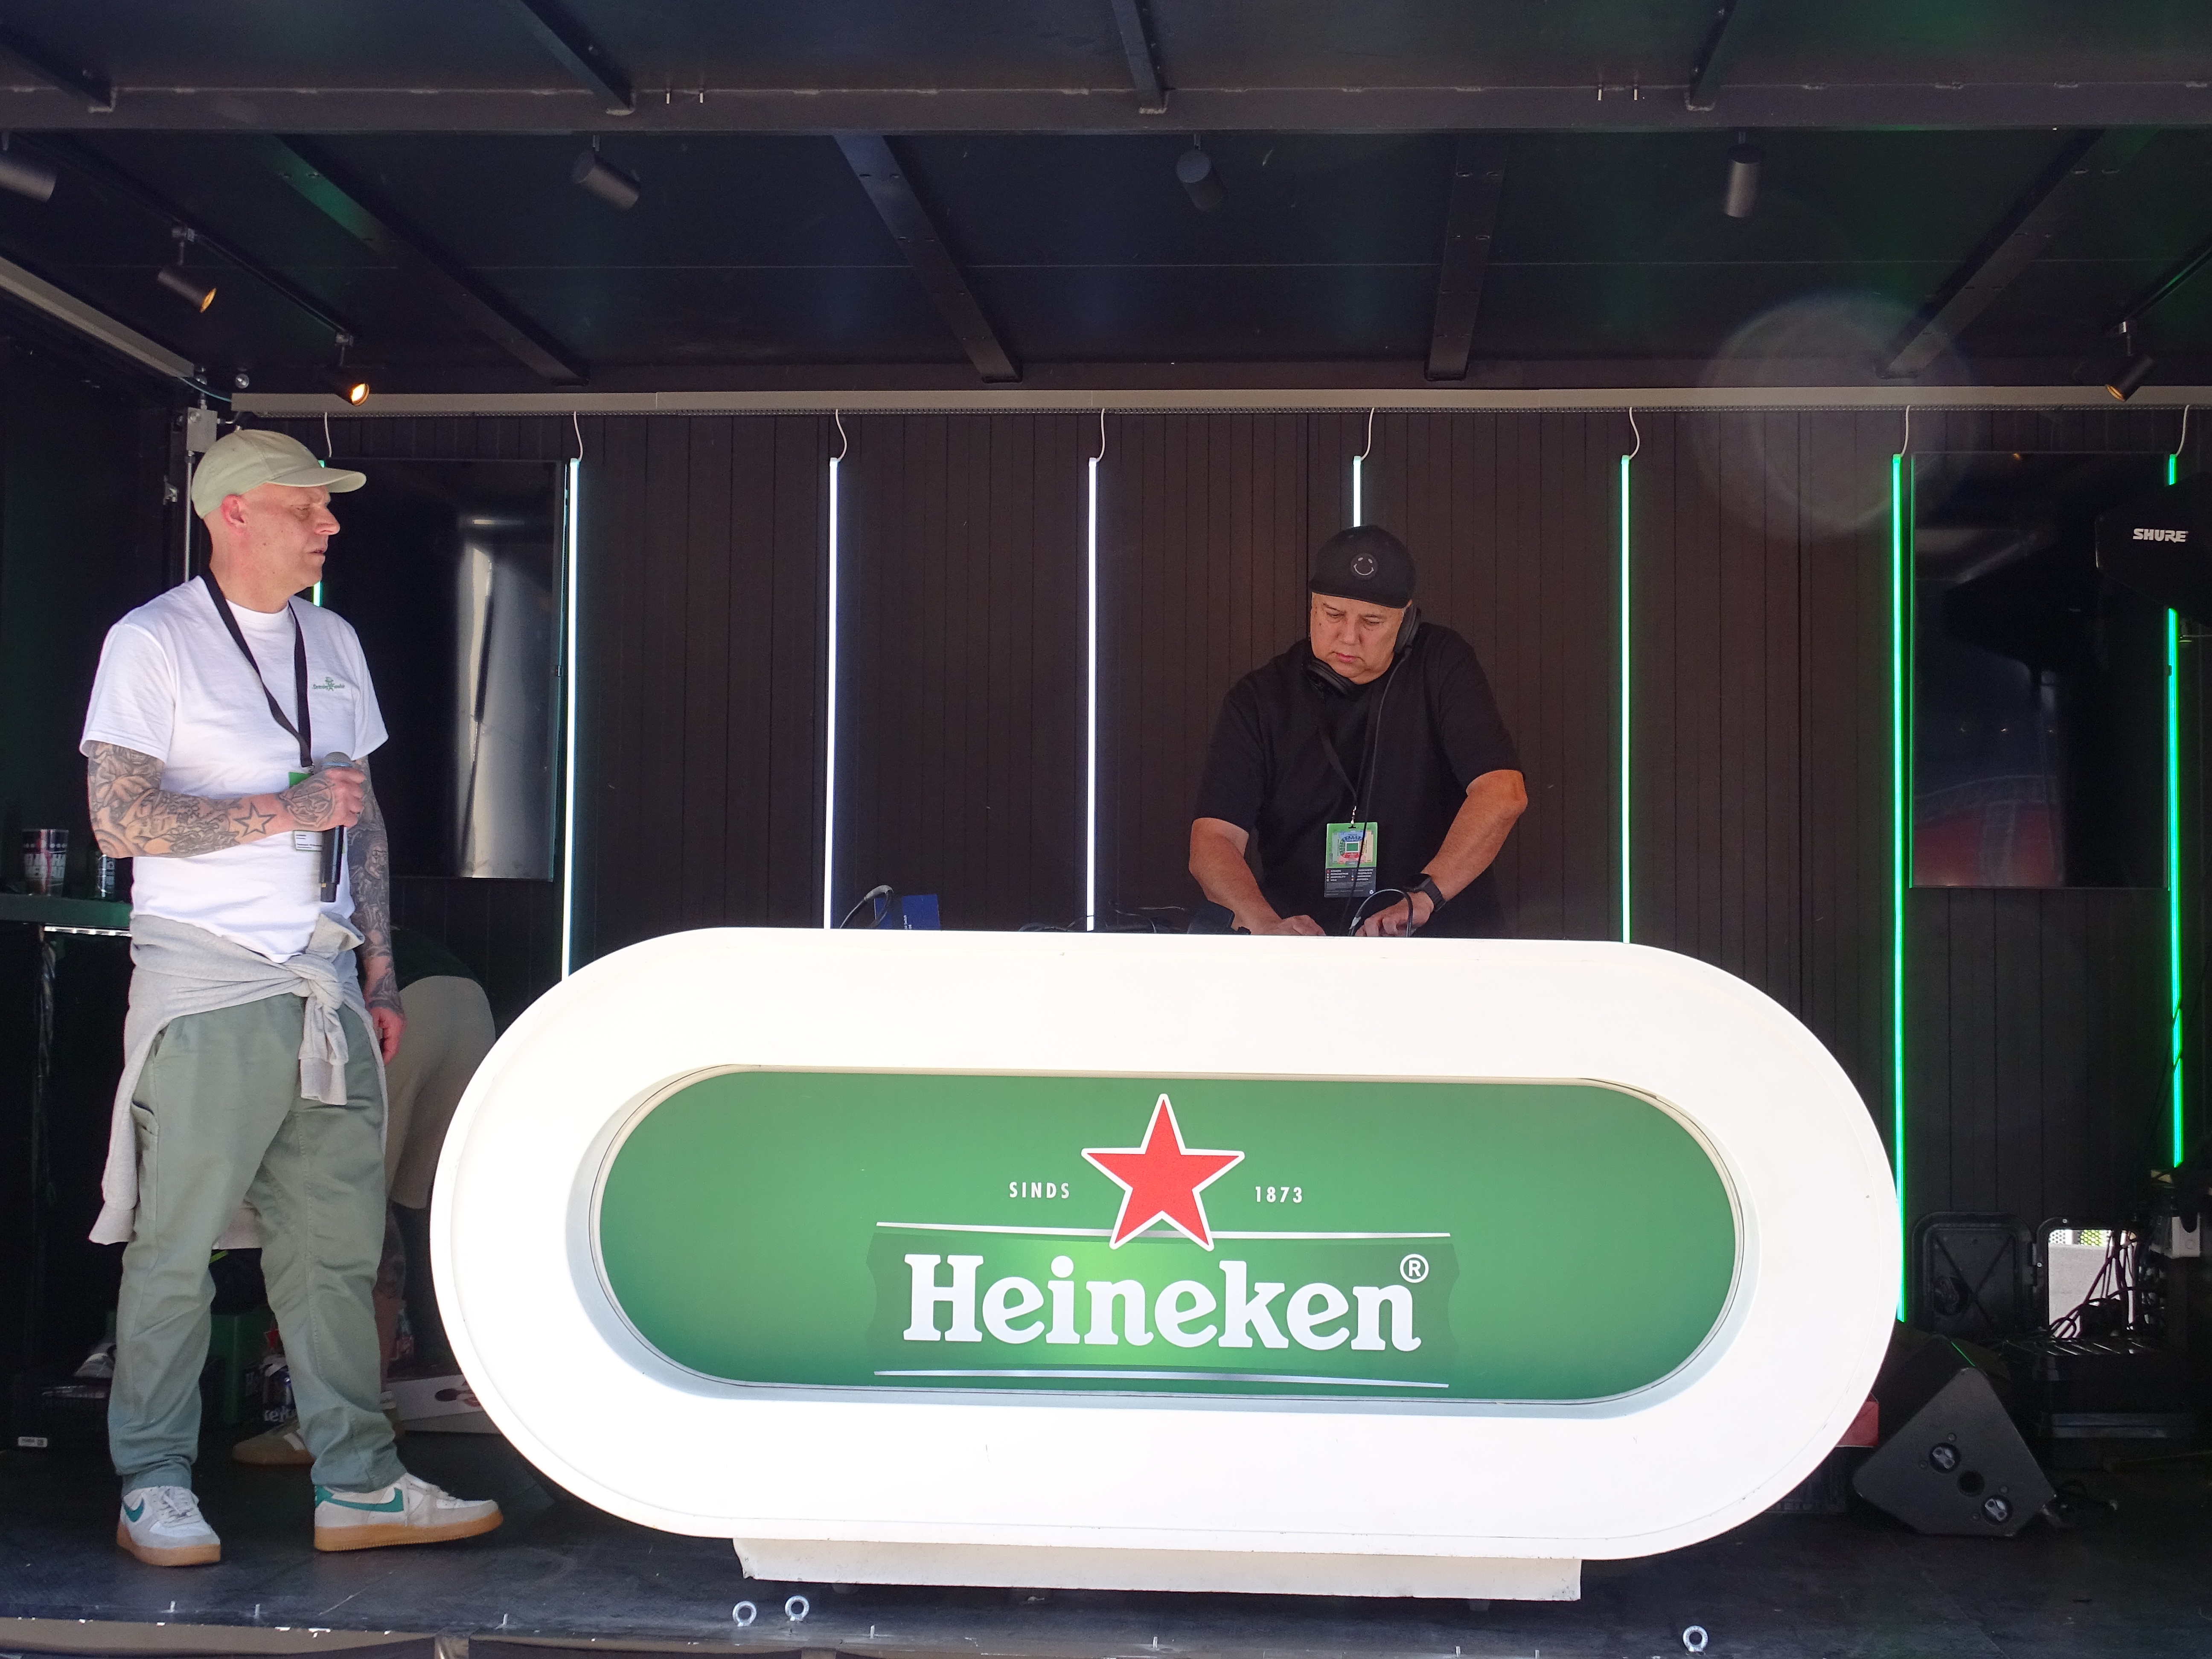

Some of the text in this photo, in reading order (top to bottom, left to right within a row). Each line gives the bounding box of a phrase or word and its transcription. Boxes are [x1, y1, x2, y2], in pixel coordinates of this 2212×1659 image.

[2133, 528, 2186, 543] SHURE
[1009, 1182, 1069, 1199] SINDS
[1255, 1186, 1303, 1203] 1873
[903, 1254, 1421, 1351] Heineken
